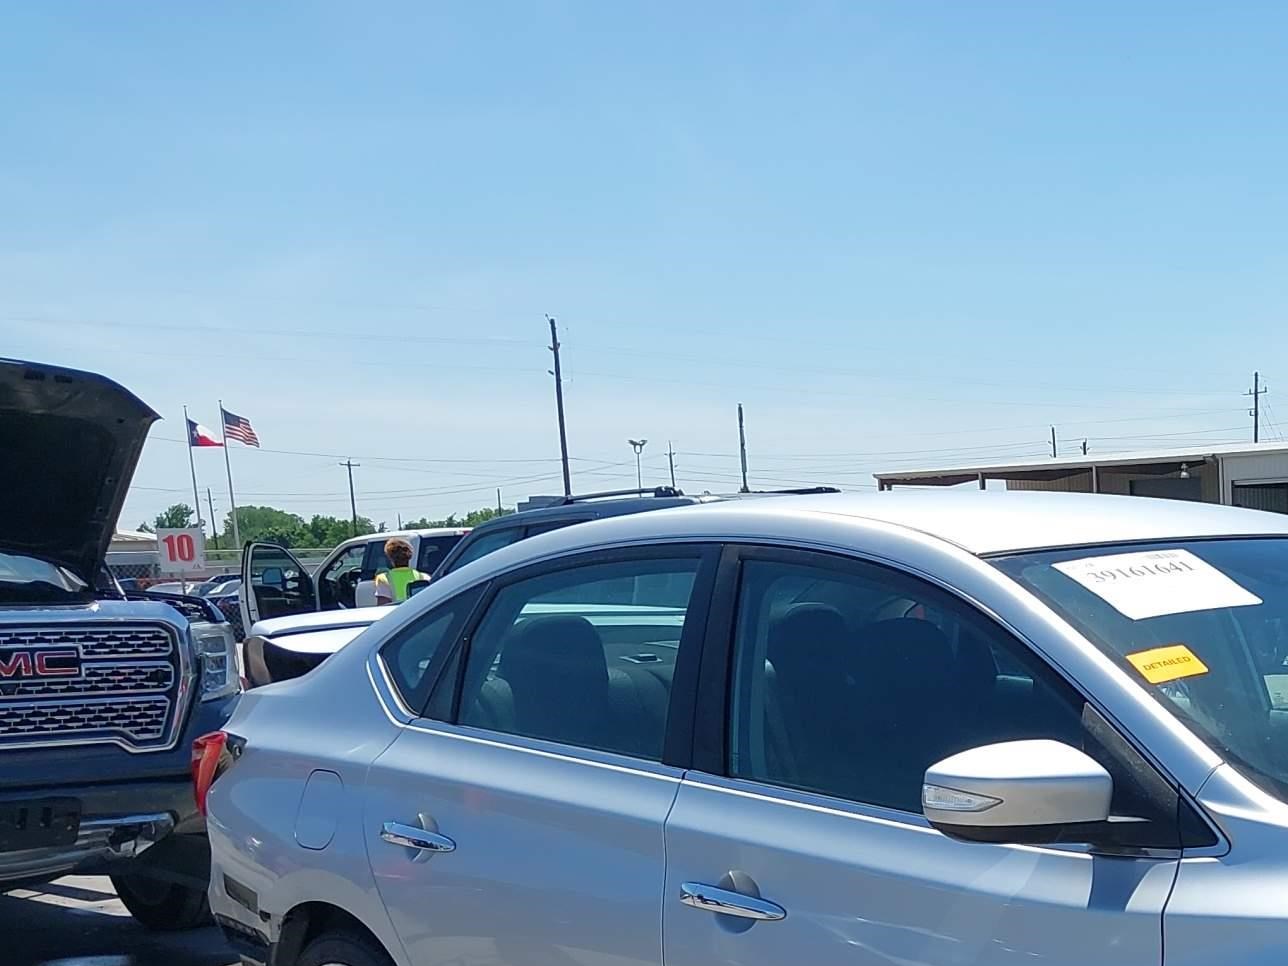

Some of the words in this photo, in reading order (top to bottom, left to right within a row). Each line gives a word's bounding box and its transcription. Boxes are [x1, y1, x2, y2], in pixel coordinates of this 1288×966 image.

[162, 534, 195, 562] 10
[1087, 561, 1195, 582] 39161641
[0, 651, 79, 677] MC
[1143, 656, 1191, 671] DETAILED
